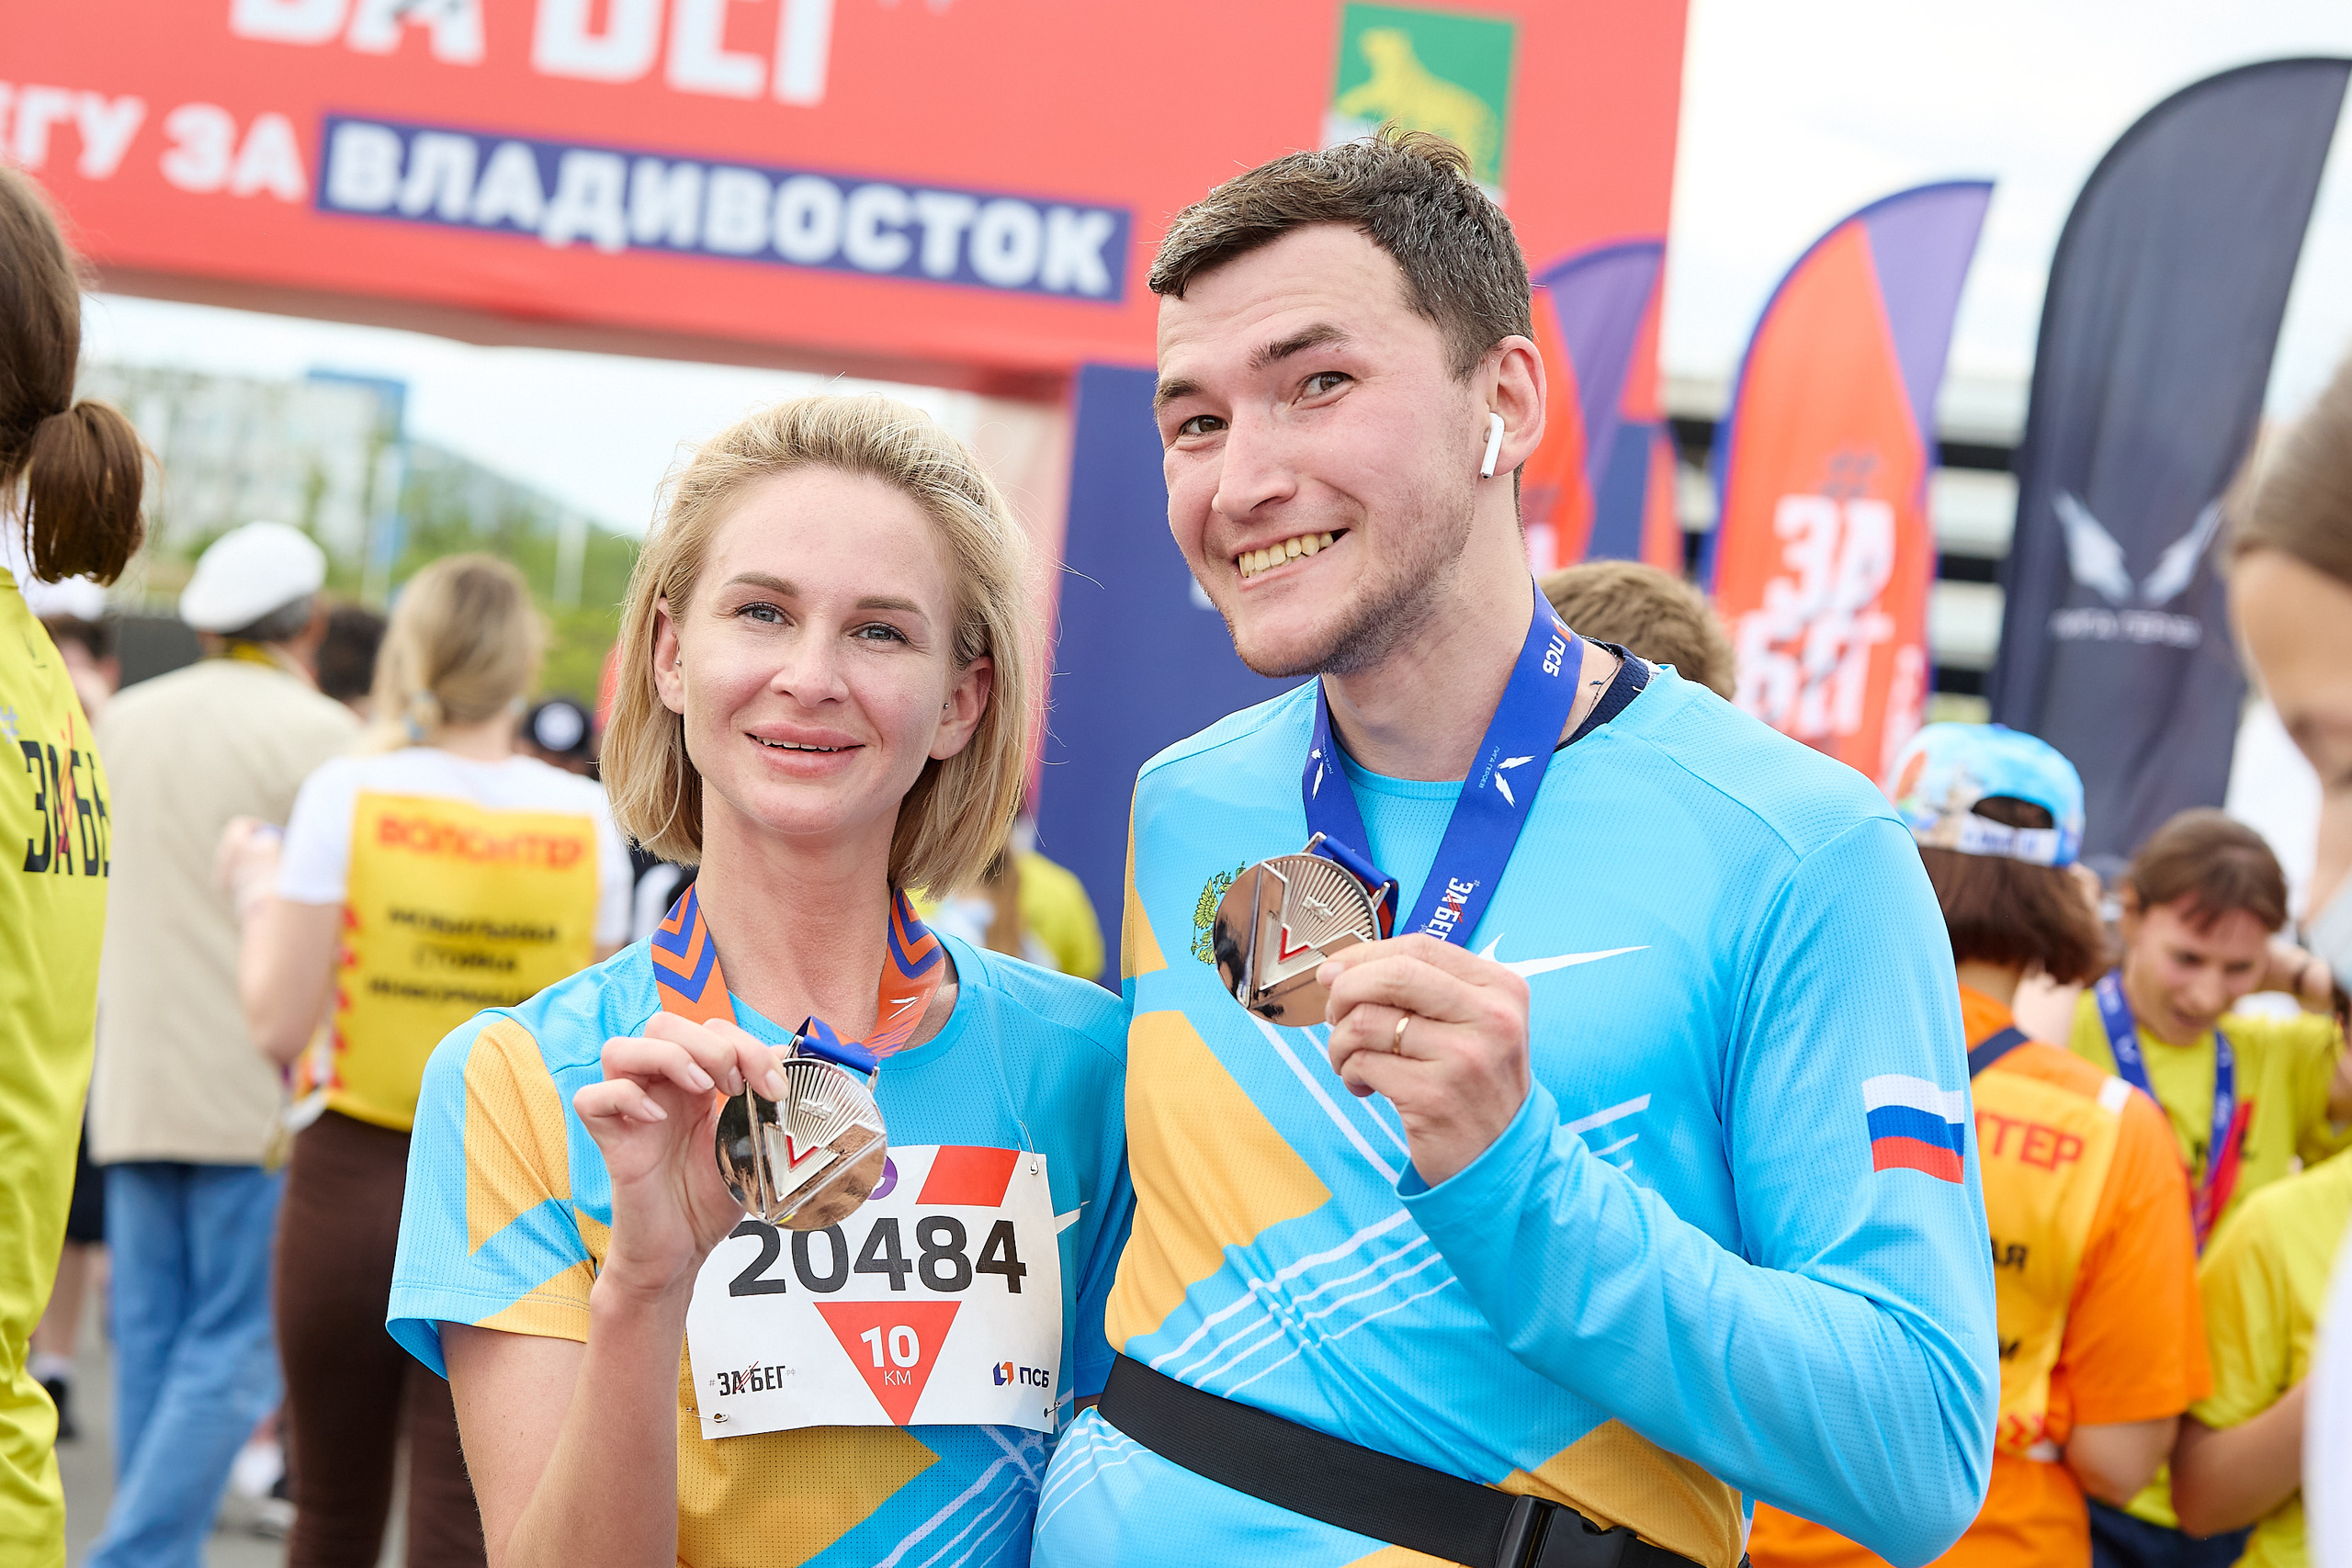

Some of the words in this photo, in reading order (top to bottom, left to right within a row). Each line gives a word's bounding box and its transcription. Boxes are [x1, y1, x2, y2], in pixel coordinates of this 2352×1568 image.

[160, 103, 307, 202] ЗА
[325, 120, 1119, 296] ВЛАДИВОСТОК
[1543, 634, 1566, 677] ПСБ
[728, 1215, 1027, 1297] 20484
[860, 1325, 920, 1369] 10
[883, 1370, 912, 1386] КМ
[1019, 1366, 1050, 1388] ПСБ
